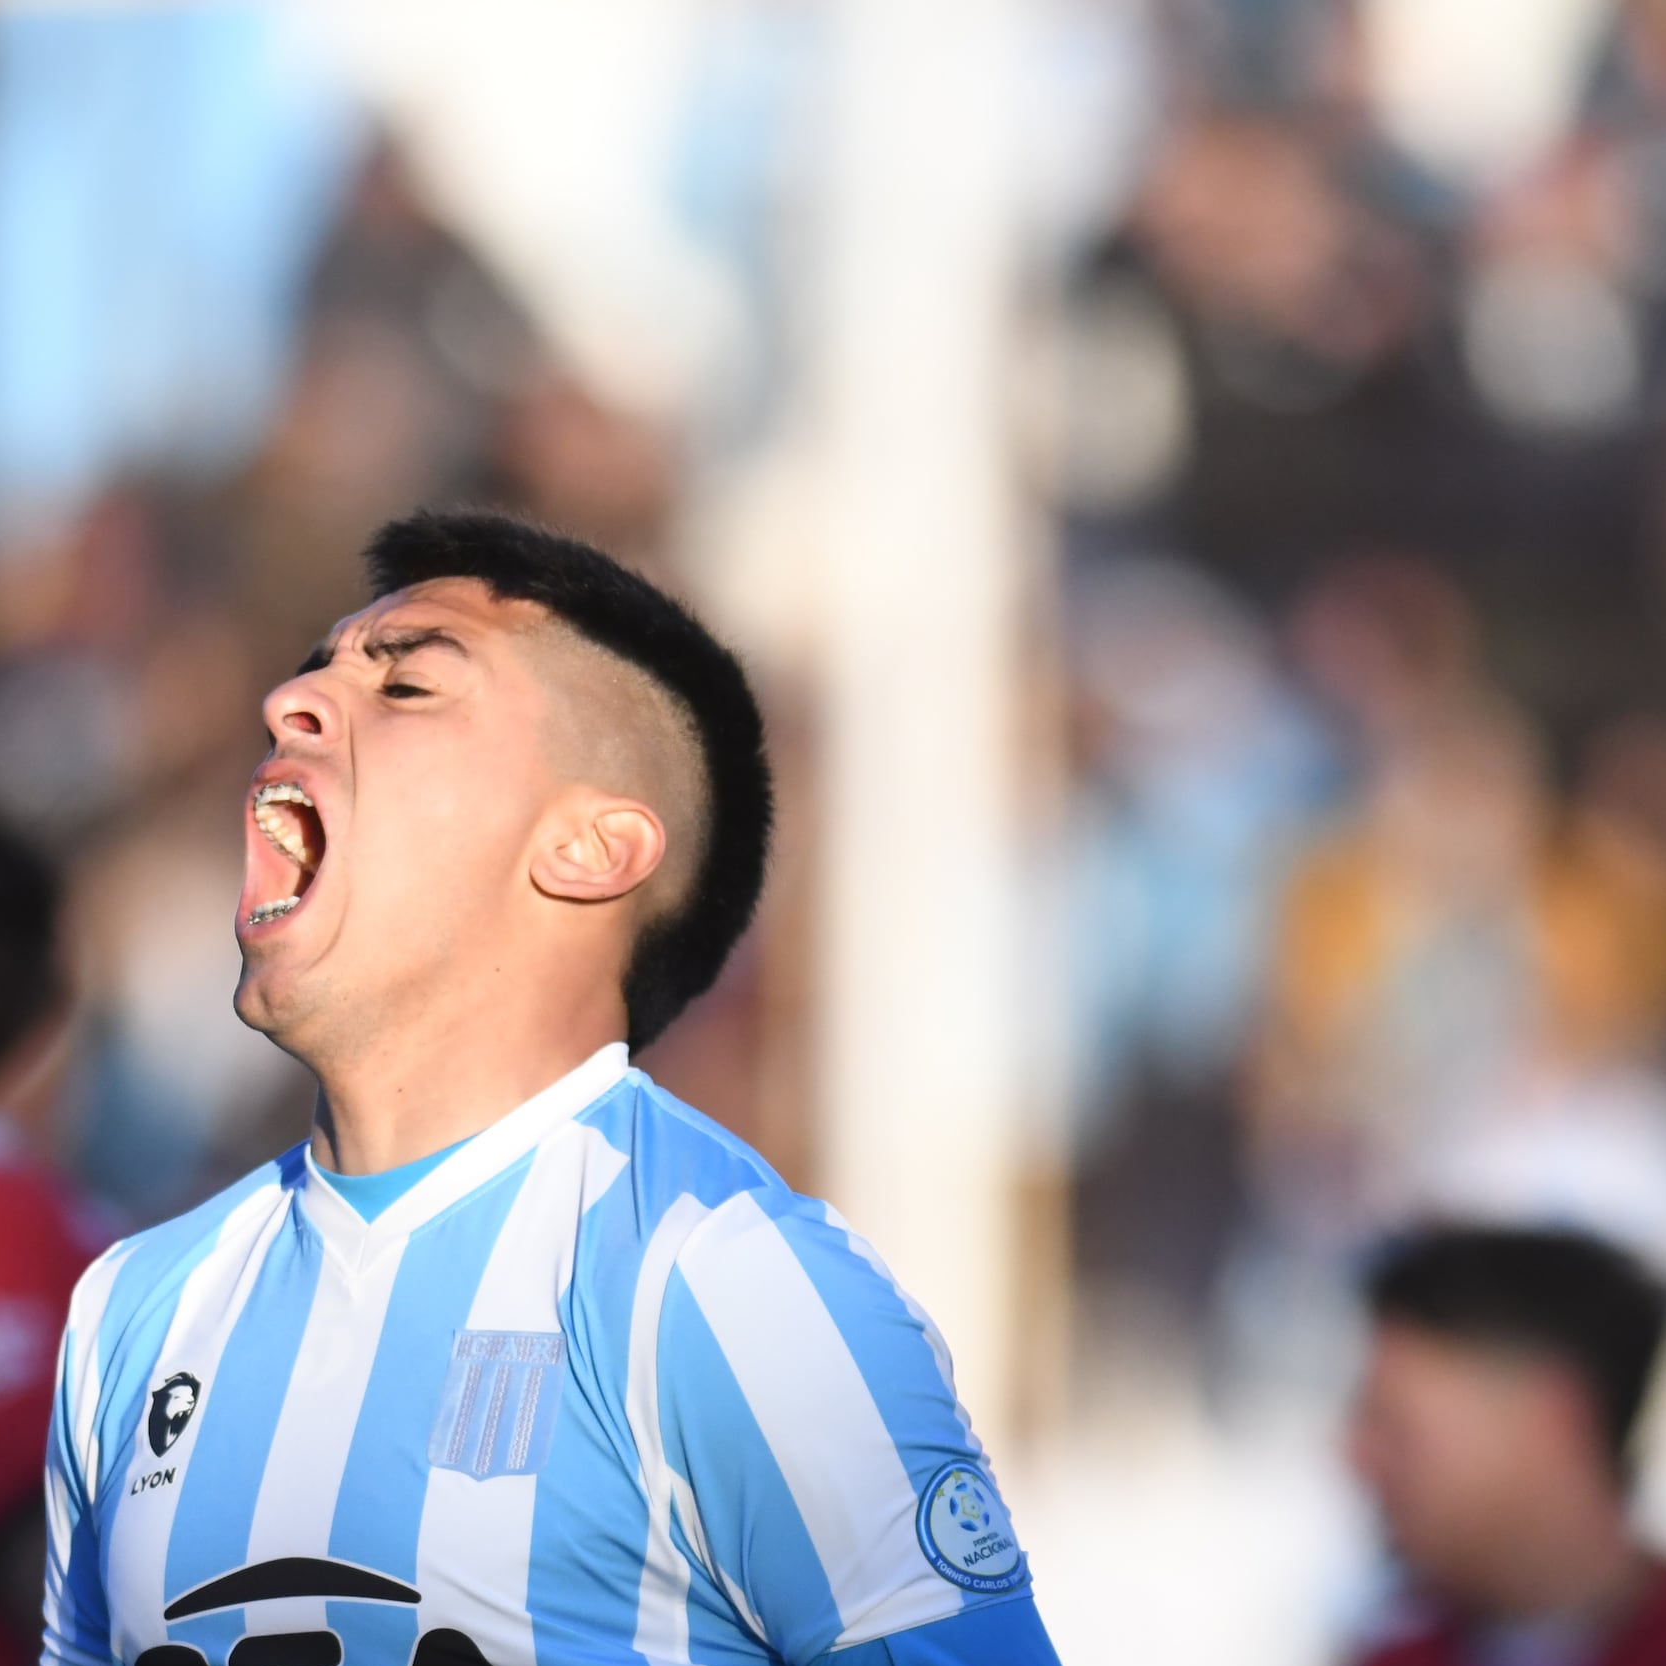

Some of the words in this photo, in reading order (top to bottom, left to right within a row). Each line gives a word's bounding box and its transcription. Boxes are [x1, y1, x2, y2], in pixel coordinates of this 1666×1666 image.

[130, 1467, 177, 1497] LYON
[935, 1558, 971, 1586] TORNEO
[972, 1578, 1010, 1590] CARLOS
